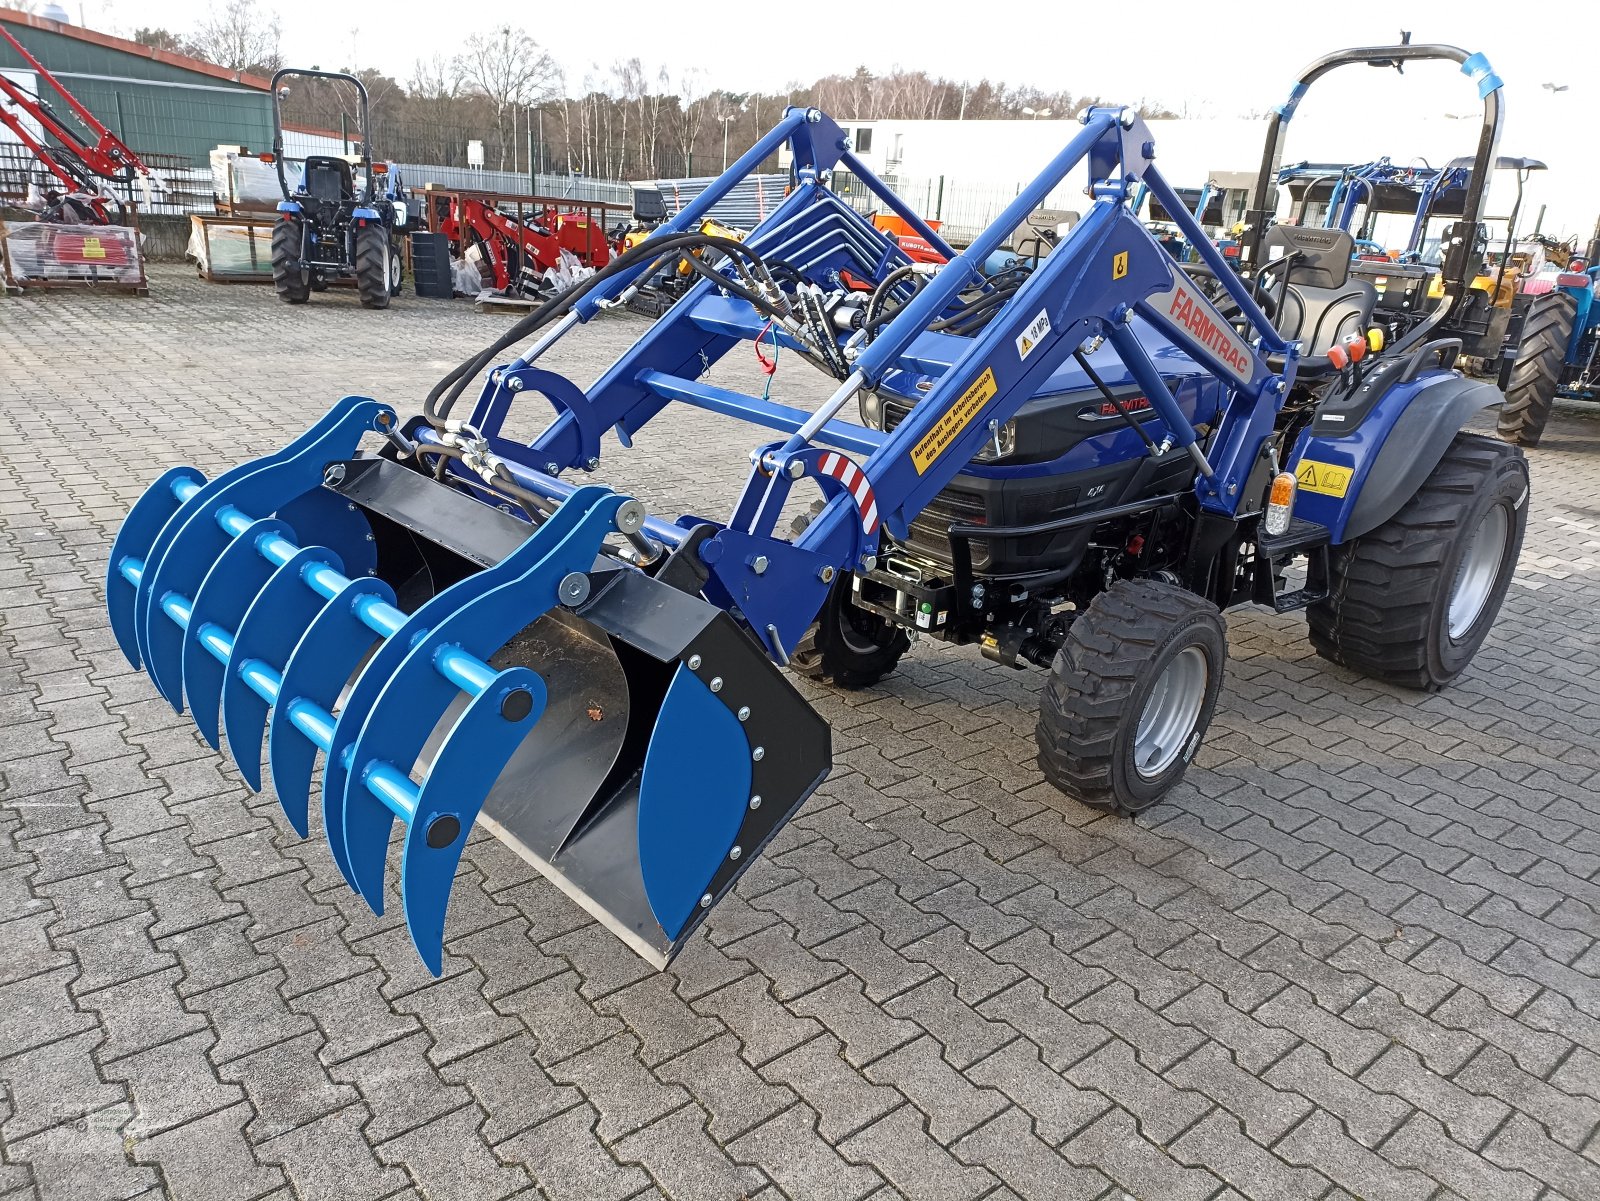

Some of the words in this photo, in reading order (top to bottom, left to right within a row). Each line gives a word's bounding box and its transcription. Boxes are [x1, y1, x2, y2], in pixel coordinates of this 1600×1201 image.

[901, 241, 924, 250] KUBOTA
[1030, 325, 1039, 340] 18
[1036, 317, 1049, 334] MPa
[1169, 286, 1248, 374] FARMTRAC
[914, 424, 944, 459] Aufenthalt
[943, 415, 953, 427] im
[952, 373, 991, 418] Arbeitsbereich
[925, 447, 937, 461] des
[936, 417, 964, 449] Auslegers
[963, 391, 988, 419] verboten
